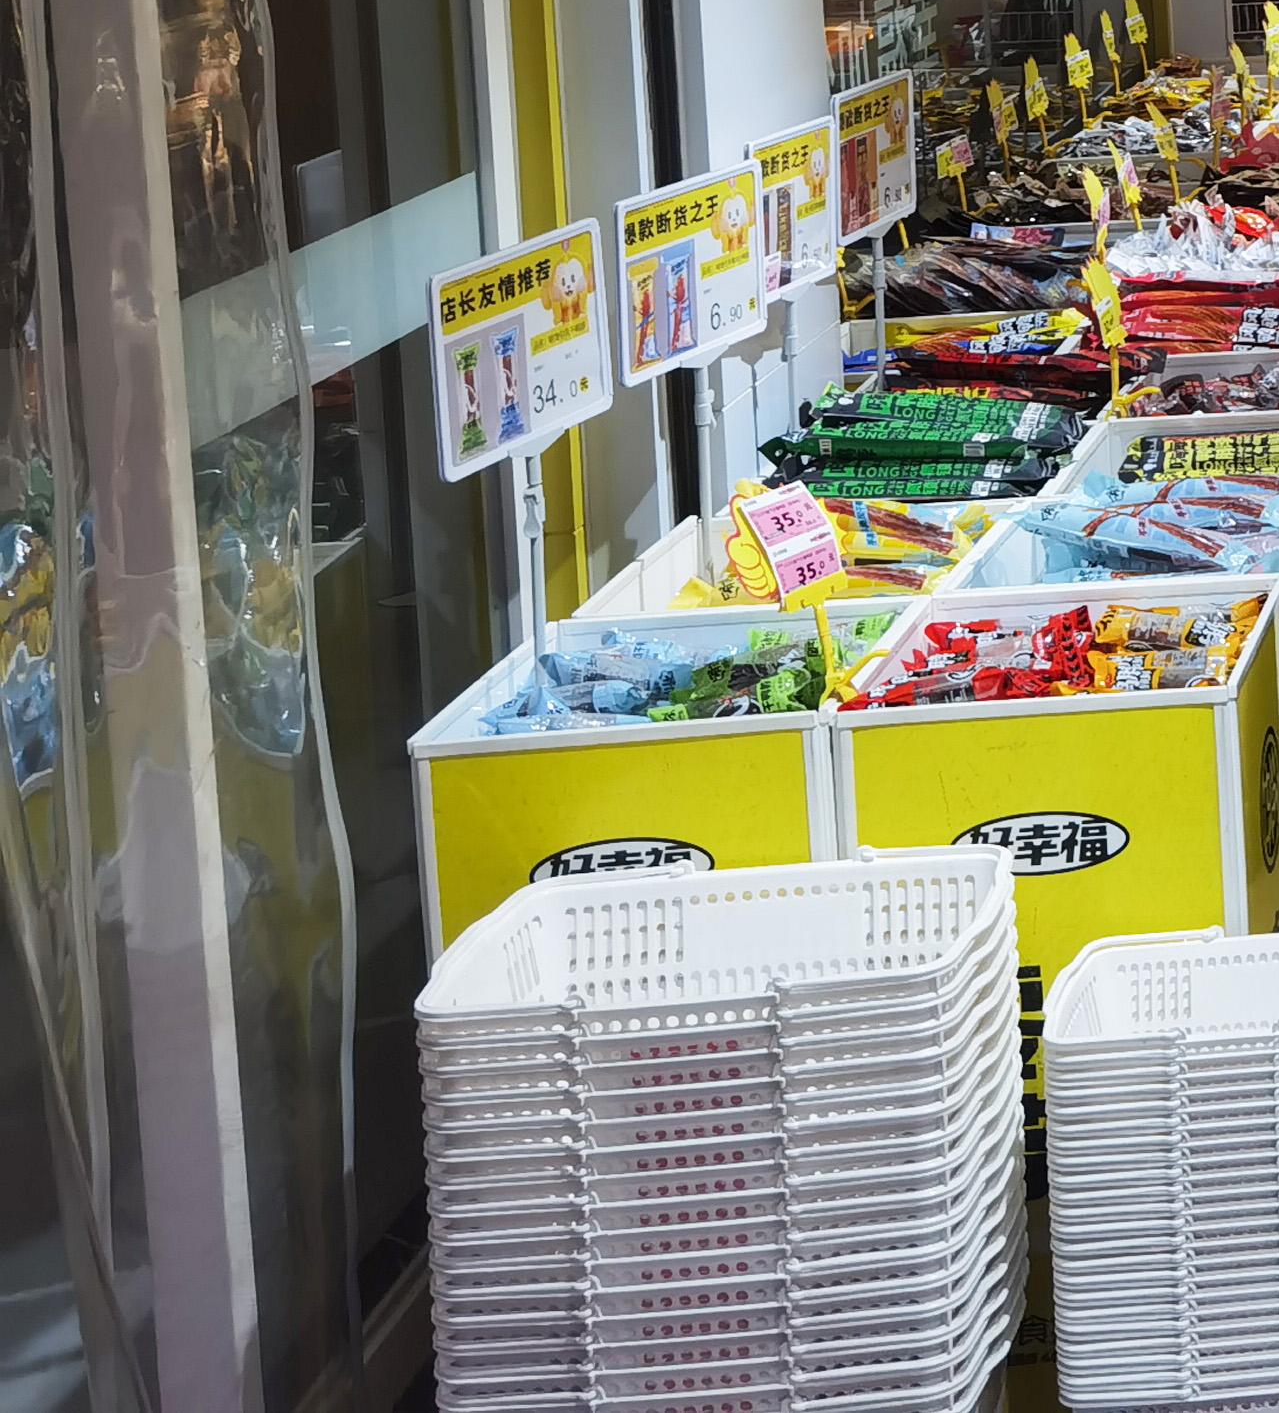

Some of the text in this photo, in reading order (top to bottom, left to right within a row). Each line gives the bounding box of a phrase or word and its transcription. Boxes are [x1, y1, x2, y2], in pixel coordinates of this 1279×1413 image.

[624, 194, 719, 247] 爆款断货之王
[440, 258, 551, 325] 店长友情推荐
[710, 302, 743, 331] 6.90
[894, 406, 938, 420] LONG
[858, 465, 901, 479] LONG
[843, 483, 886, 497] LONG
[969, 820, 1111, 866] 好幸福
